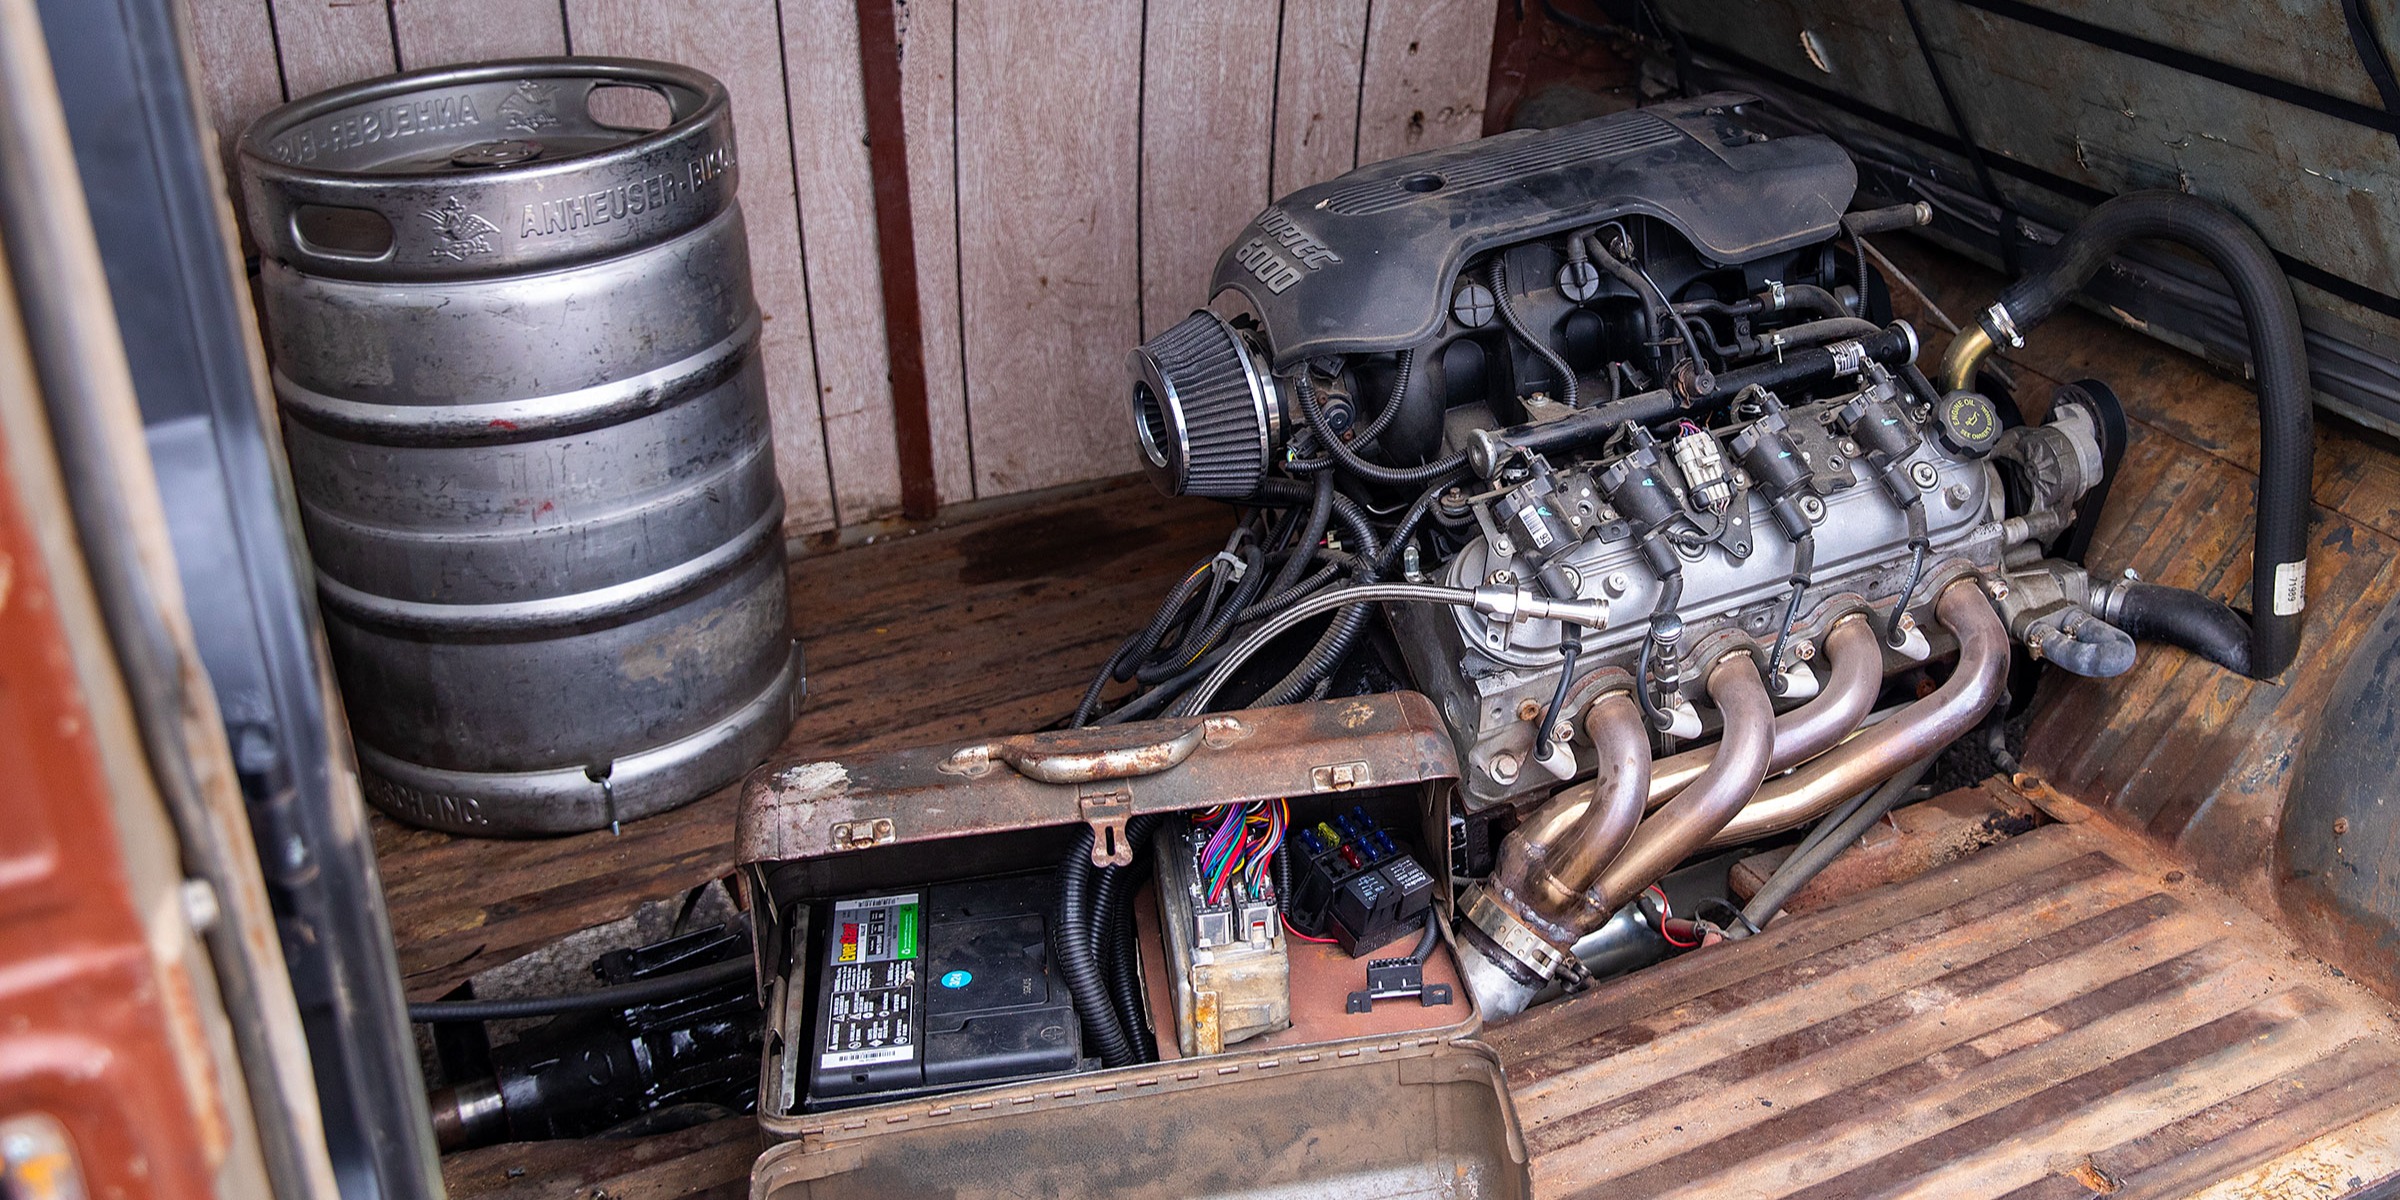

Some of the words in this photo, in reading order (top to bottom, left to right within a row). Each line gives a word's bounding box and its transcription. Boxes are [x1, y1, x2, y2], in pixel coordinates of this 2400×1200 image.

[1256, 206, 1342, 271] VORTEC
[1235, 237, 1302, 296] 6000
[1951, 400, 1965, 426] ENGINE
[1964, 398, 1975, 407] OIL
[1540, 533, 1551, 544] 93
[434, 794, 488, 826] INC.
[839, 923, 857, 962] EverStart
